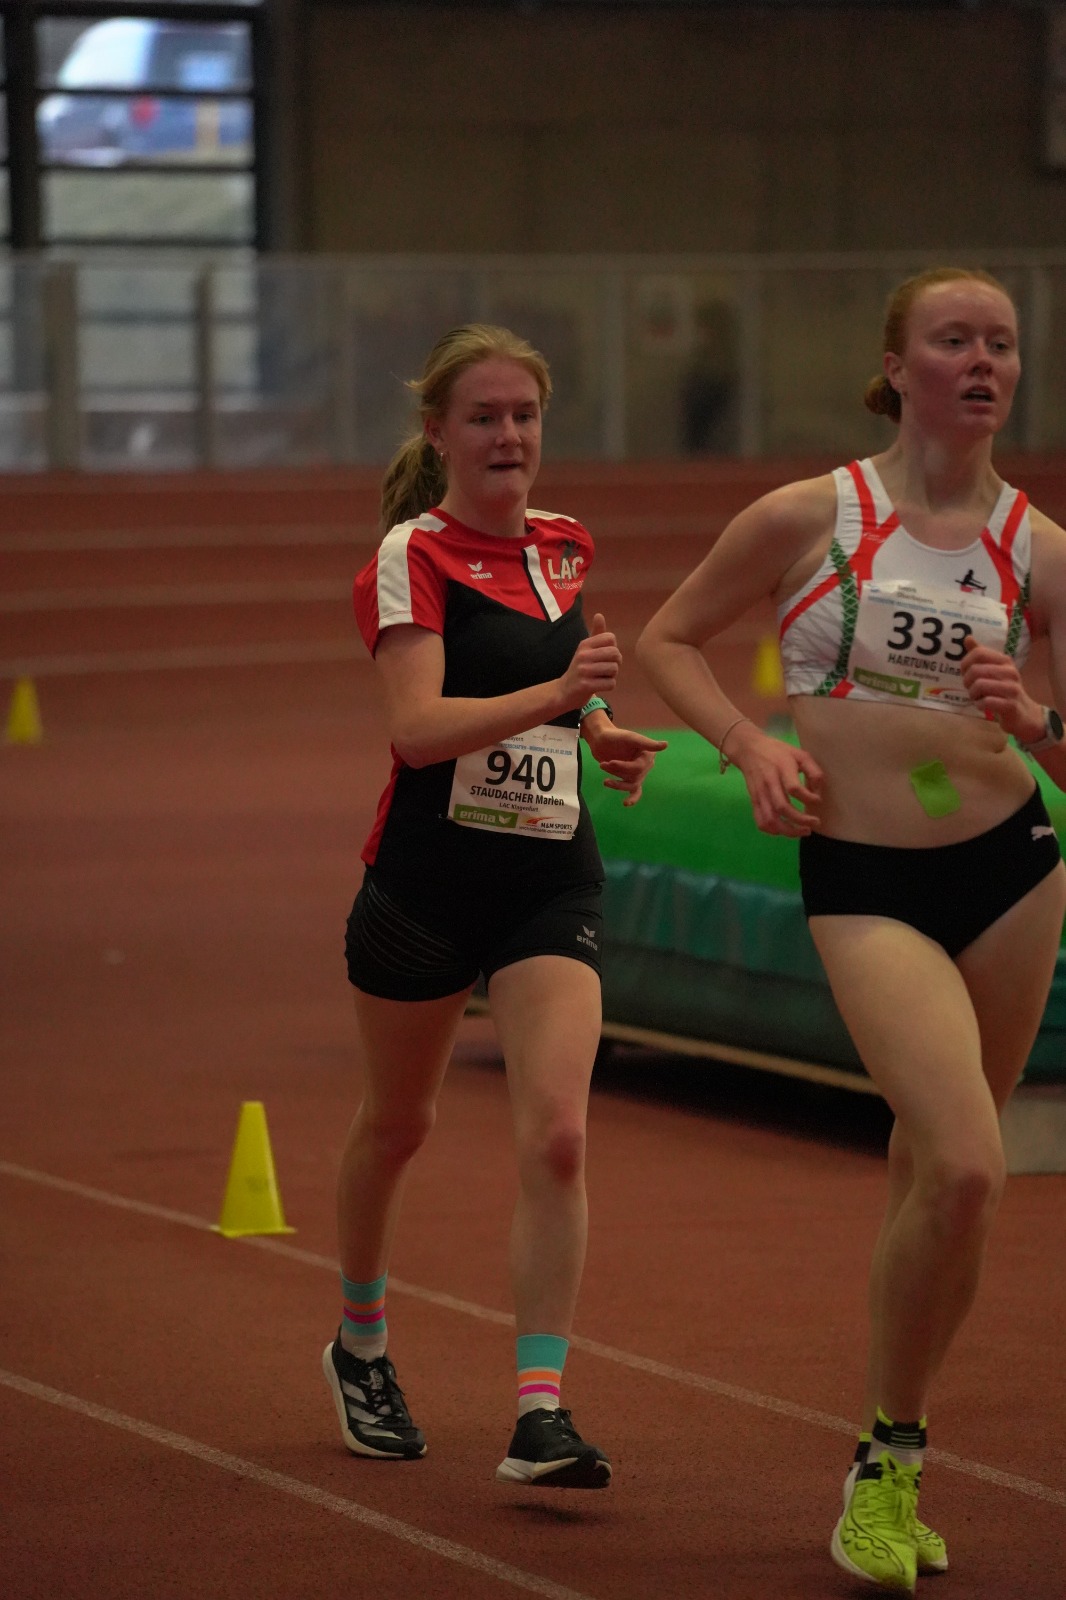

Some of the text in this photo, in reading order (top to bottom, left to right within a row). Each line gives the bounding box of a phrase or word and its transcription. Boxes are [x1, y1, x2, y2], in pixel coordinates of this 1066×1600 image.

[470, 572, 493, 580] erima
[547, 556, 584, 580] LAC
[887, 611, 973, 662] 333
[887, 653, 961, 677] HARTUNG Lina
[485, 750, 556, 792] 940
[470, 785, 534, 804] STAUDACHER
[460, 810, 496, 823] erima
[541, 822, 554, 830] M&M
[554, 823, 573, 831] SPORTS
[576, 934, 598, 951] erima
